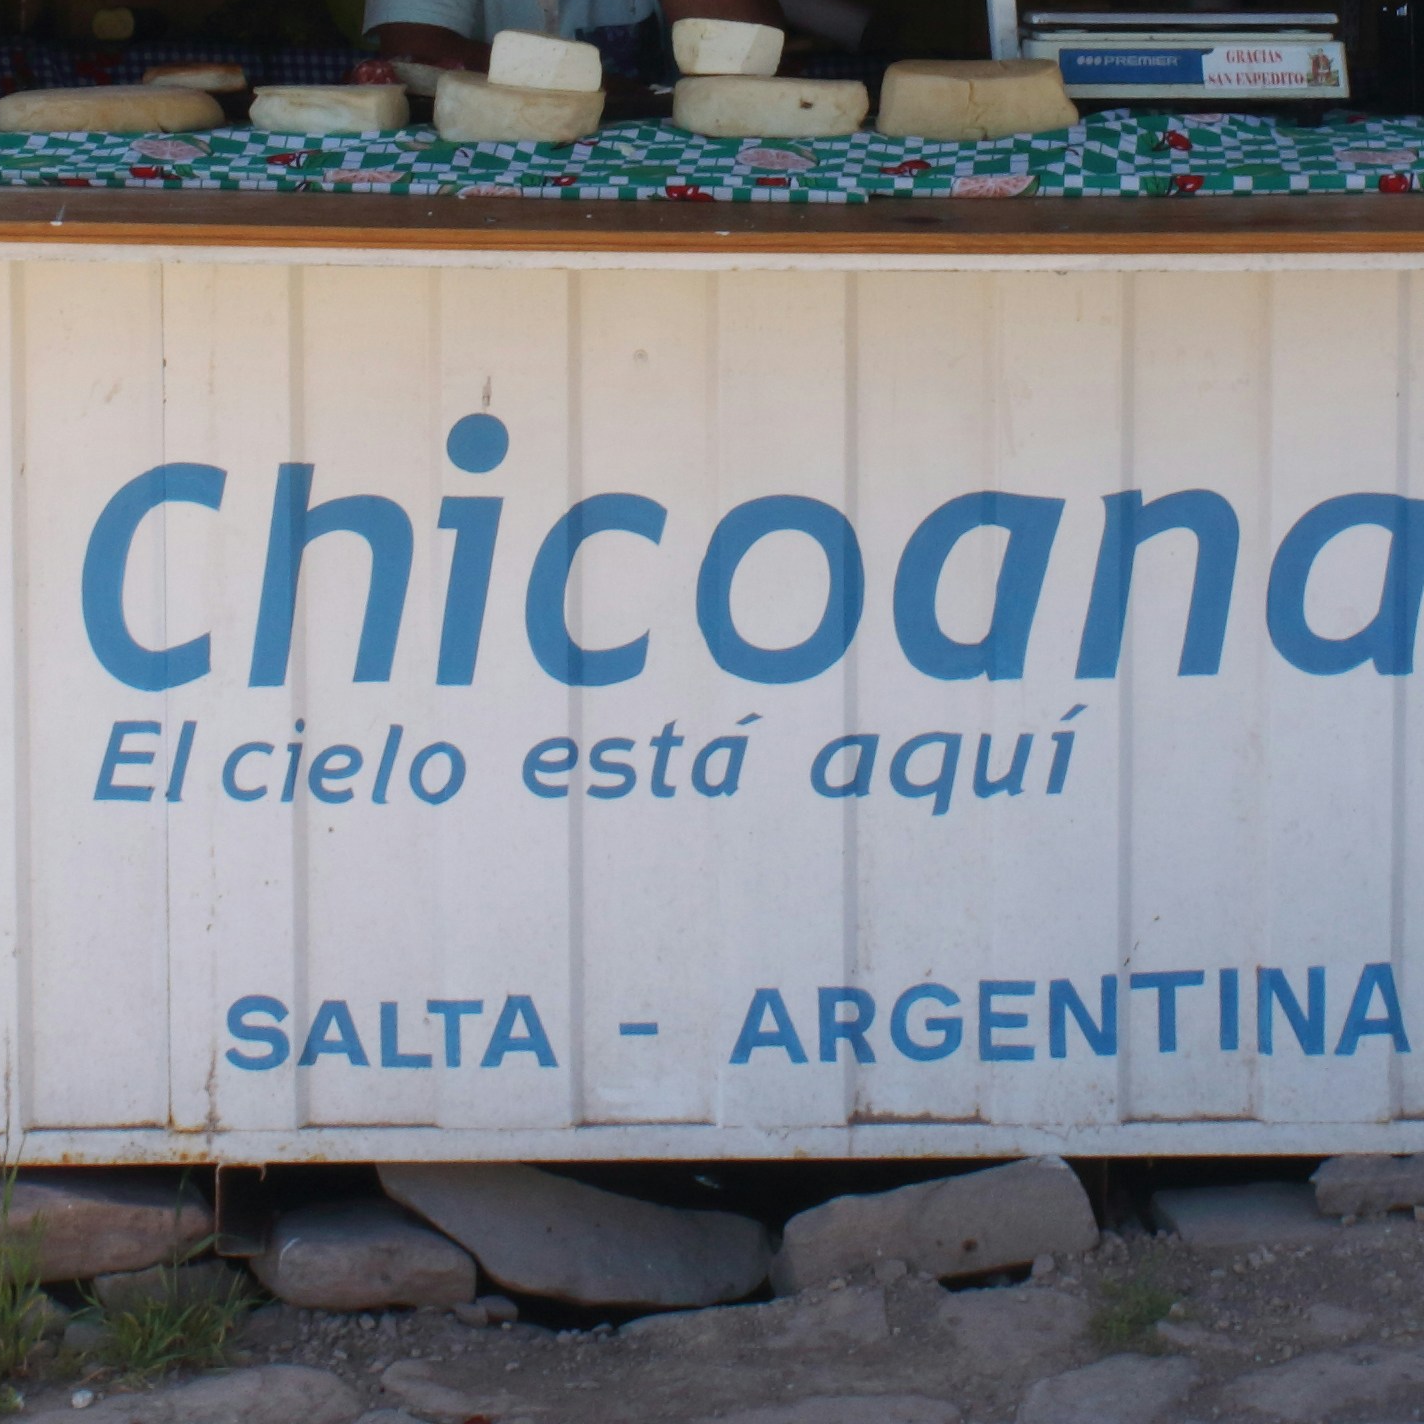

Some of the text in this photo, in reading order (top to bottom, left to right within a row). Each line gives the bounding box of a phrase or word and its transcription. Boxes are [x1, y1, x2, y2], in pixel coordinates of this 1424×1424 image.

[1103, 54, 1179, 66] PREMIER
[1226, 49, 1284, 64] GRACIAS
[1207, 71, 1305, 87] SAN EXPEDITO
[92, 703, 1087, 818] El cielo está aquí
[224, 994, 559, 1072] SALTA
[727, 961, 1413, 1067] ARGENTINA
